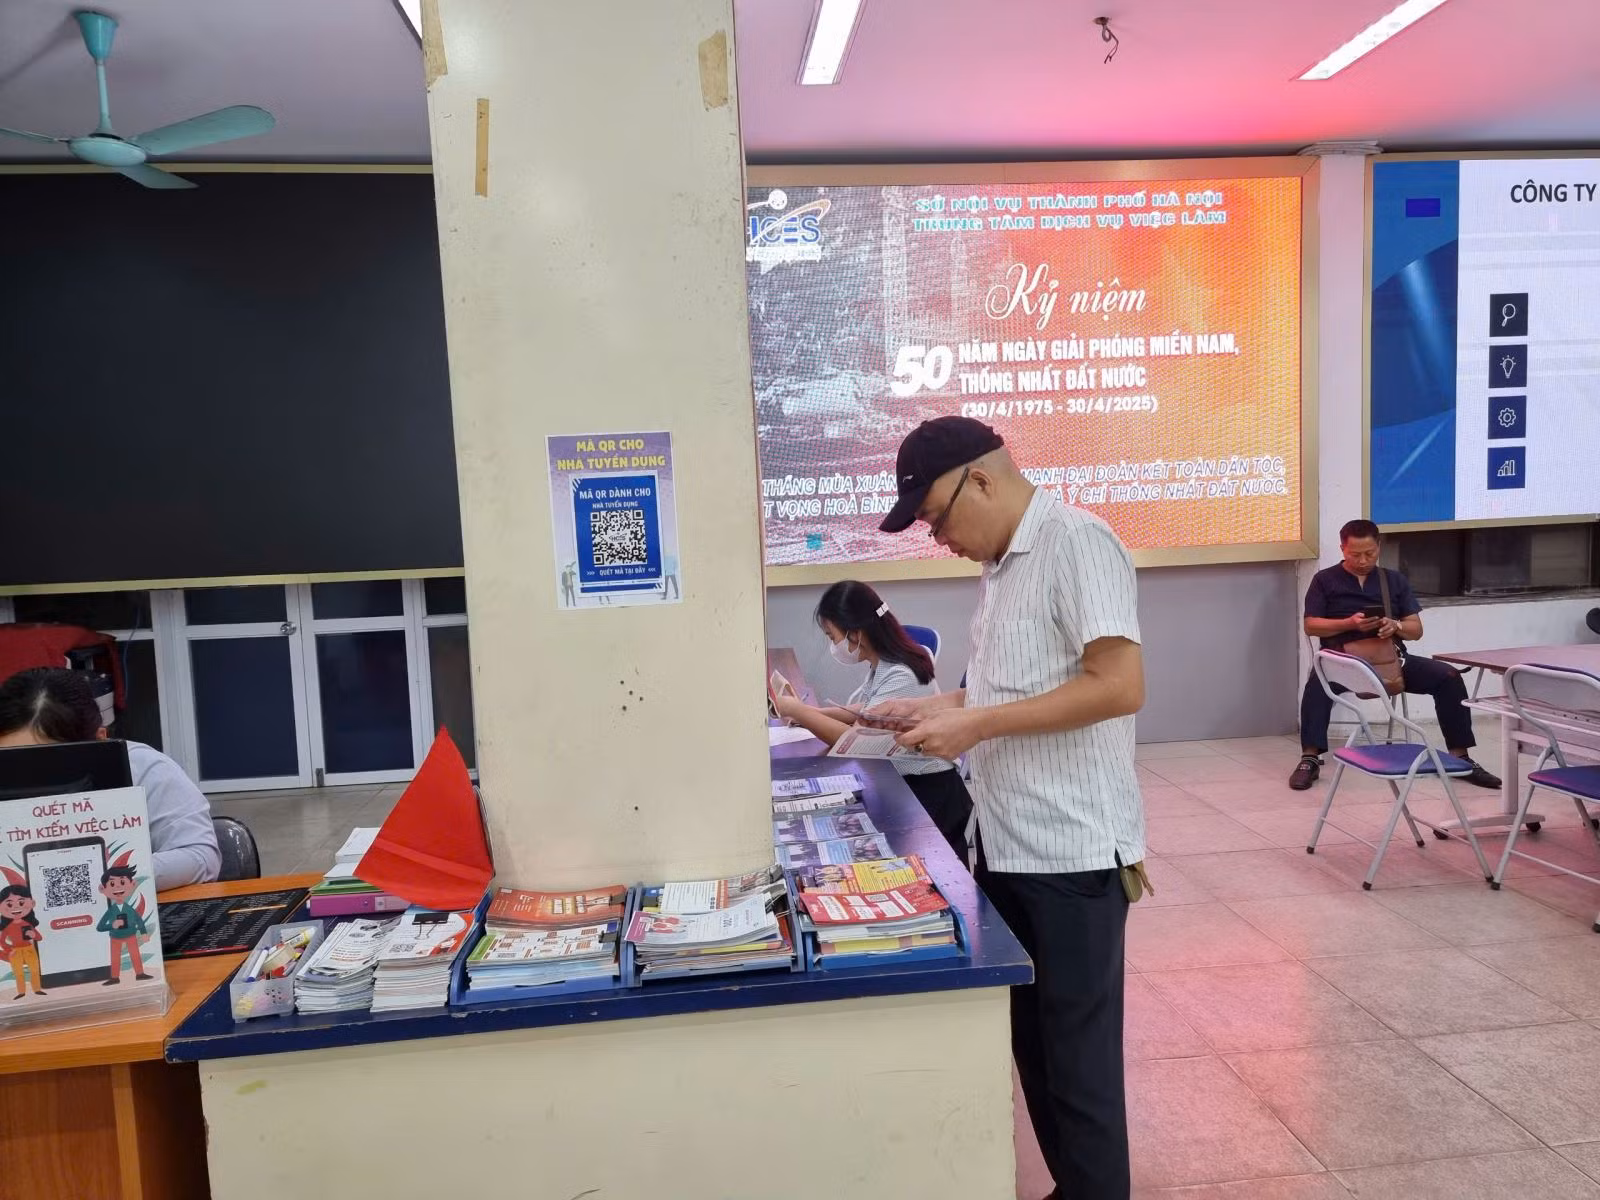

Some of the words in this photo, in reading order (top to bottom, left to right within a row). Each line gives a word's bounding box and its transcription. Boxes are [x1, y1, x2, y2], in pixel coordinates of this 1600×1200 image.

[951, 195, 988, 213] NỘI
[994, 197, 1022, 212] VỤ
[1027, 193, 1097, 210] THÀNH
[1104, 190, 1147, 208] PHỐ
[1152, 191, 1180, 207] HÀ
[1186, 190, 1222, 207] NỘI
[1510, 179, 1568, 203] CÔNG
[1573, 183, 1597, 202] TY
[913, 217, 983, 231] TRUNG
[988, 214, 1034, 229] TÂM
[1040, 215, 1091, 231] DỊCH
[1096, 214, 1124, 229] VỤ
[1129, 211, 1176, 228] VIỆC
[1181, 208, 1227, 225] LÀM
[985, 263, 1059, 330] Kỷ
[1069, 277, 1146, 321] niệm
[958, 338, 998, 363] NĂM
[1002, 337, 1046, 361] NGÀY
[1051, 333, 1084, 360] GIẢI
[1089, 334, 1145, 358] PHÓNG
[1150, 329, 1192, 355] MIỀN
[1197, 334, 1240, 355] NAM,
[889, 345, 953, 397] 50
[959, 366, 1014, 394] THỐNG
[1018, 364, 1061, 392] NHẤT
[1066, 362, 1096, 390] ĐẤT
[1101, 364, 1146, 388] NƯỚC
[961, 400, 1053, 418] (30/4/1975
[1067, 395, 1158, 414] 30/4/2025)
[576, 439, 595, 452] MÃ
[598, 440, 616, 453] QR
[619, 439, 644, 450] CHO
[557, 457, 584, 470] NHÀ
[587, 453, 628, 468] TUYỂN
[631, 455, 666, 469] DỤNG
[1067, 465, 1093, 486] ĐẠI
[1095, 460, 1138, 483] ĐOÀN
[1141, 460, 1171, 479] KẾT
[1175, 457, 1215, 478] TOÀN
[1218, 455, 1249, 475] DÂN
[579, 489, 593, 499] MÃ
[595, 490, 606, 499] QR
[609, 487, 632, 498] DÀNH
[634, 488, 651, 496] CHO
[818, 472, 854, 494] MÙA
[855, 470, 898, 493] XUÂN
[1110, 481, 1161, 502] THỐNG
[1164, 480, 1206, 500] NHẤT
[1208, 477, 1238, 498] ĐẤT
[776, 499, 821, 520] VỌNG
[824, 494, 858, 516] HOÀ
[32, 801, 67, 817] QUÉT
[73, 798, 94, 813] MÃ
[7, 827, 31, 842] TÌM
[36, 820, 69, 838] KIẾM
[75, 817, 109, 834] VIỆC
[113, 814, 142, 830] LÀM
